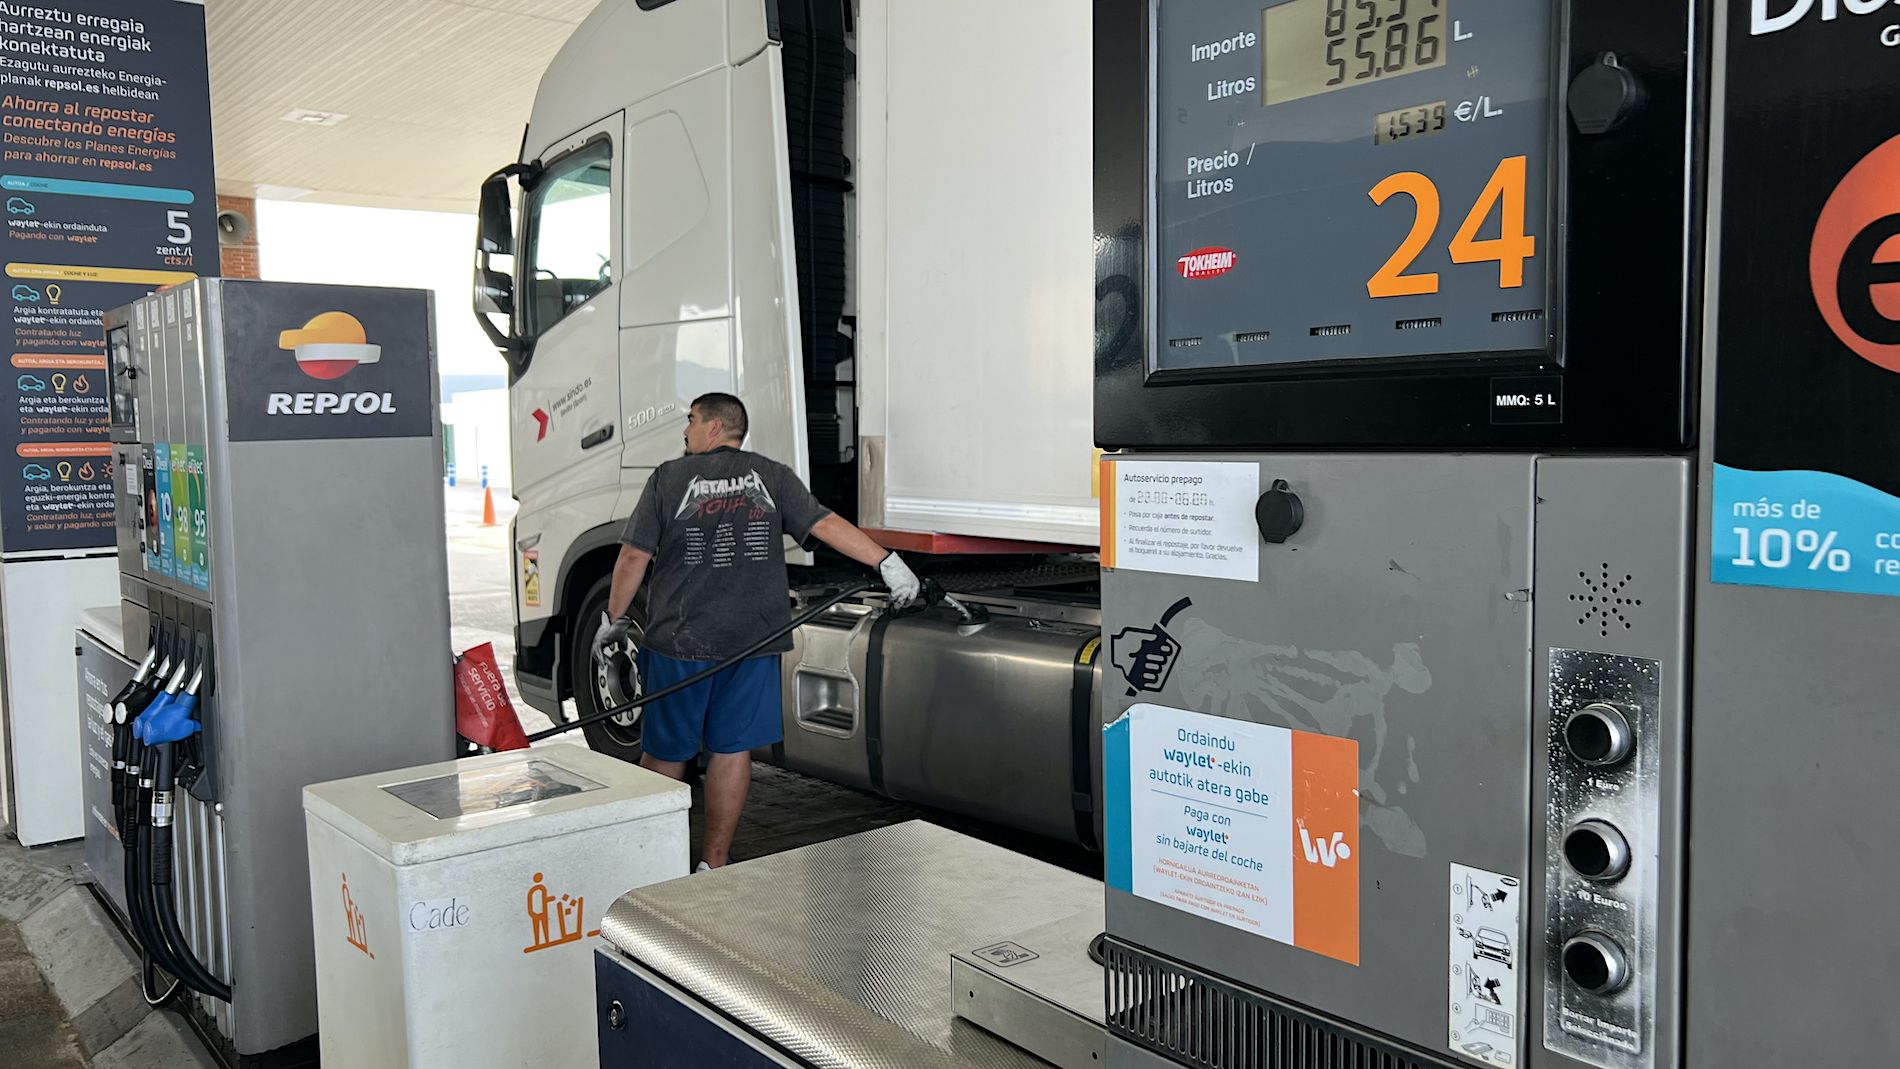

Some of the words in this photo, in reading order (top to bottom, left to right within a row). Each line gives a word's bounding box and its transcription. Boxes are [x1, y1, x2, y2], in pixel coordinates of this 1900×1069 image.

[0, 1, 71, 23] Aurreztu
[77, 13, 144, 34] erregaia
[0, 18, 75, 41] hartzean
[80, 31, 152, 52] energiak
[0, 36, 105, 63] konektatuta
[1191, 32, 1256, 62] Importe
[1326, 14, 1439, 86] 55,86
[0, 56, 49, 72] Ezagutu
[52, 64, 116, 80] aurrezteko
[118, 71, 168, 87] Energia-
[0, 72, 41, 87] planak
[45, 79, 100, 94] repsol.es
[102, 83, 159, 100] helbidean
[1208, 77, 1256, 100] Litros
[2, 95, 59, 114] Ahorra
[64, 102, 80, 116] al
[84, 105, 154, 124] repostar
[3, 115, 102, 135] conectando
[107, 126, 176, 144] energías
[1389, 104, 1445, 140] 1,539
[4, 132, 61, 148] Descubre
[64, 138, 82, 150] los
[86, 140, 124, 154] Planes
[128, 144, 176, 159] Energías
[4, 150, 32, 161] para
[36, 152, 79, 165] ahorrar
[82, 157, 96, 166] en
[100, 158, 152, 172] repsol.es
[1188, 150, 1239, 175] Precio
[1188, 178, 1234, 198] Litros
[9, 230, 47, 241] Pagando
[62, 222, 108, 232] ordainduta
[167, 209, 192, 245] 5
[1366, 155, 1535, 298] 24
[156, 246, 192, 256] zent./l
[1178, 252, 1232, 278] TOKHEIM
[14, 306, 36, 316] Argia
[38, 306, 89, 316] kontratatuta
[15, 328, 67, 337] Contratando
[22, 338, 60, 346] pagando
[19, 396, 42, 405] Argia
[58, 396, 104, 404] berokuntza
[20, 406, 34, 414] eta
[267, 392, 396, 415] REPSOL
[1496, 394, 1530, 406] MMQ:
[1534, 394, 1544, 406] 5
[1548, 394, 1556, 406] L
[20, 416, 72, 424] Contratando
[628, 406, 656, 430] 500
[28, 426, 64, 434] pagando
[25, 485, 49, 494] Argia,
[50, 484, 97, 492] berokuntza
[1124, 474, 1170, 483] Autoservicio
[1171, 476, 1203, 486] prepago
[25, 494, 87, 503] eguzki-energia
[88, 492, 115, 500] kontra
[674, 468, 776, 519] METALLICA
[26, 503, 40, 511] eta
[26, 512, 80, 521] Contratando
[161, 492, 172, 522] 10
[1129, 510, 1142, 518] Pasa
[1152, 512, 1163, 520] caja
[1733, 496, 1784, 518] más
[1791, 499, 1821, 519] de
[34, 522, 55, 530] solar
[64, 521, 100, 530] pagando
[178, 506, 189, 532] 98
[194, 509, 206, 538] 95
[1160, 526, 1180, 534] número
[1732, 527, 1851, 572] 10%
[468, 667, 496, 711] servicio
[1178, 728, 1235, 752] Ordaindu
[1164, 748, 1214, 769] waylet
[1150, 768, 1193, 788] autotik
[1197, 779, 1232, 797] atera
[1236, 788, 1269, 806] gabe
[1587, 776, 1594, 787] 1
[1596, 779, 1620, 791] Euro
[1184, 806, 1209, 822] Paga
[1212, 814, 1231, 826] con
[1186, 826, 1228, 844] waylet
[1156, 834, 1170, 846] sin
[1173, 837, 1209, 857] bajarte
[1212, 848, 1228, 862] del
[1231, 855, 1263, 872] coche
[1593, 893, 1627, 910] Euros
[409, 898, 470, 931] Cade
